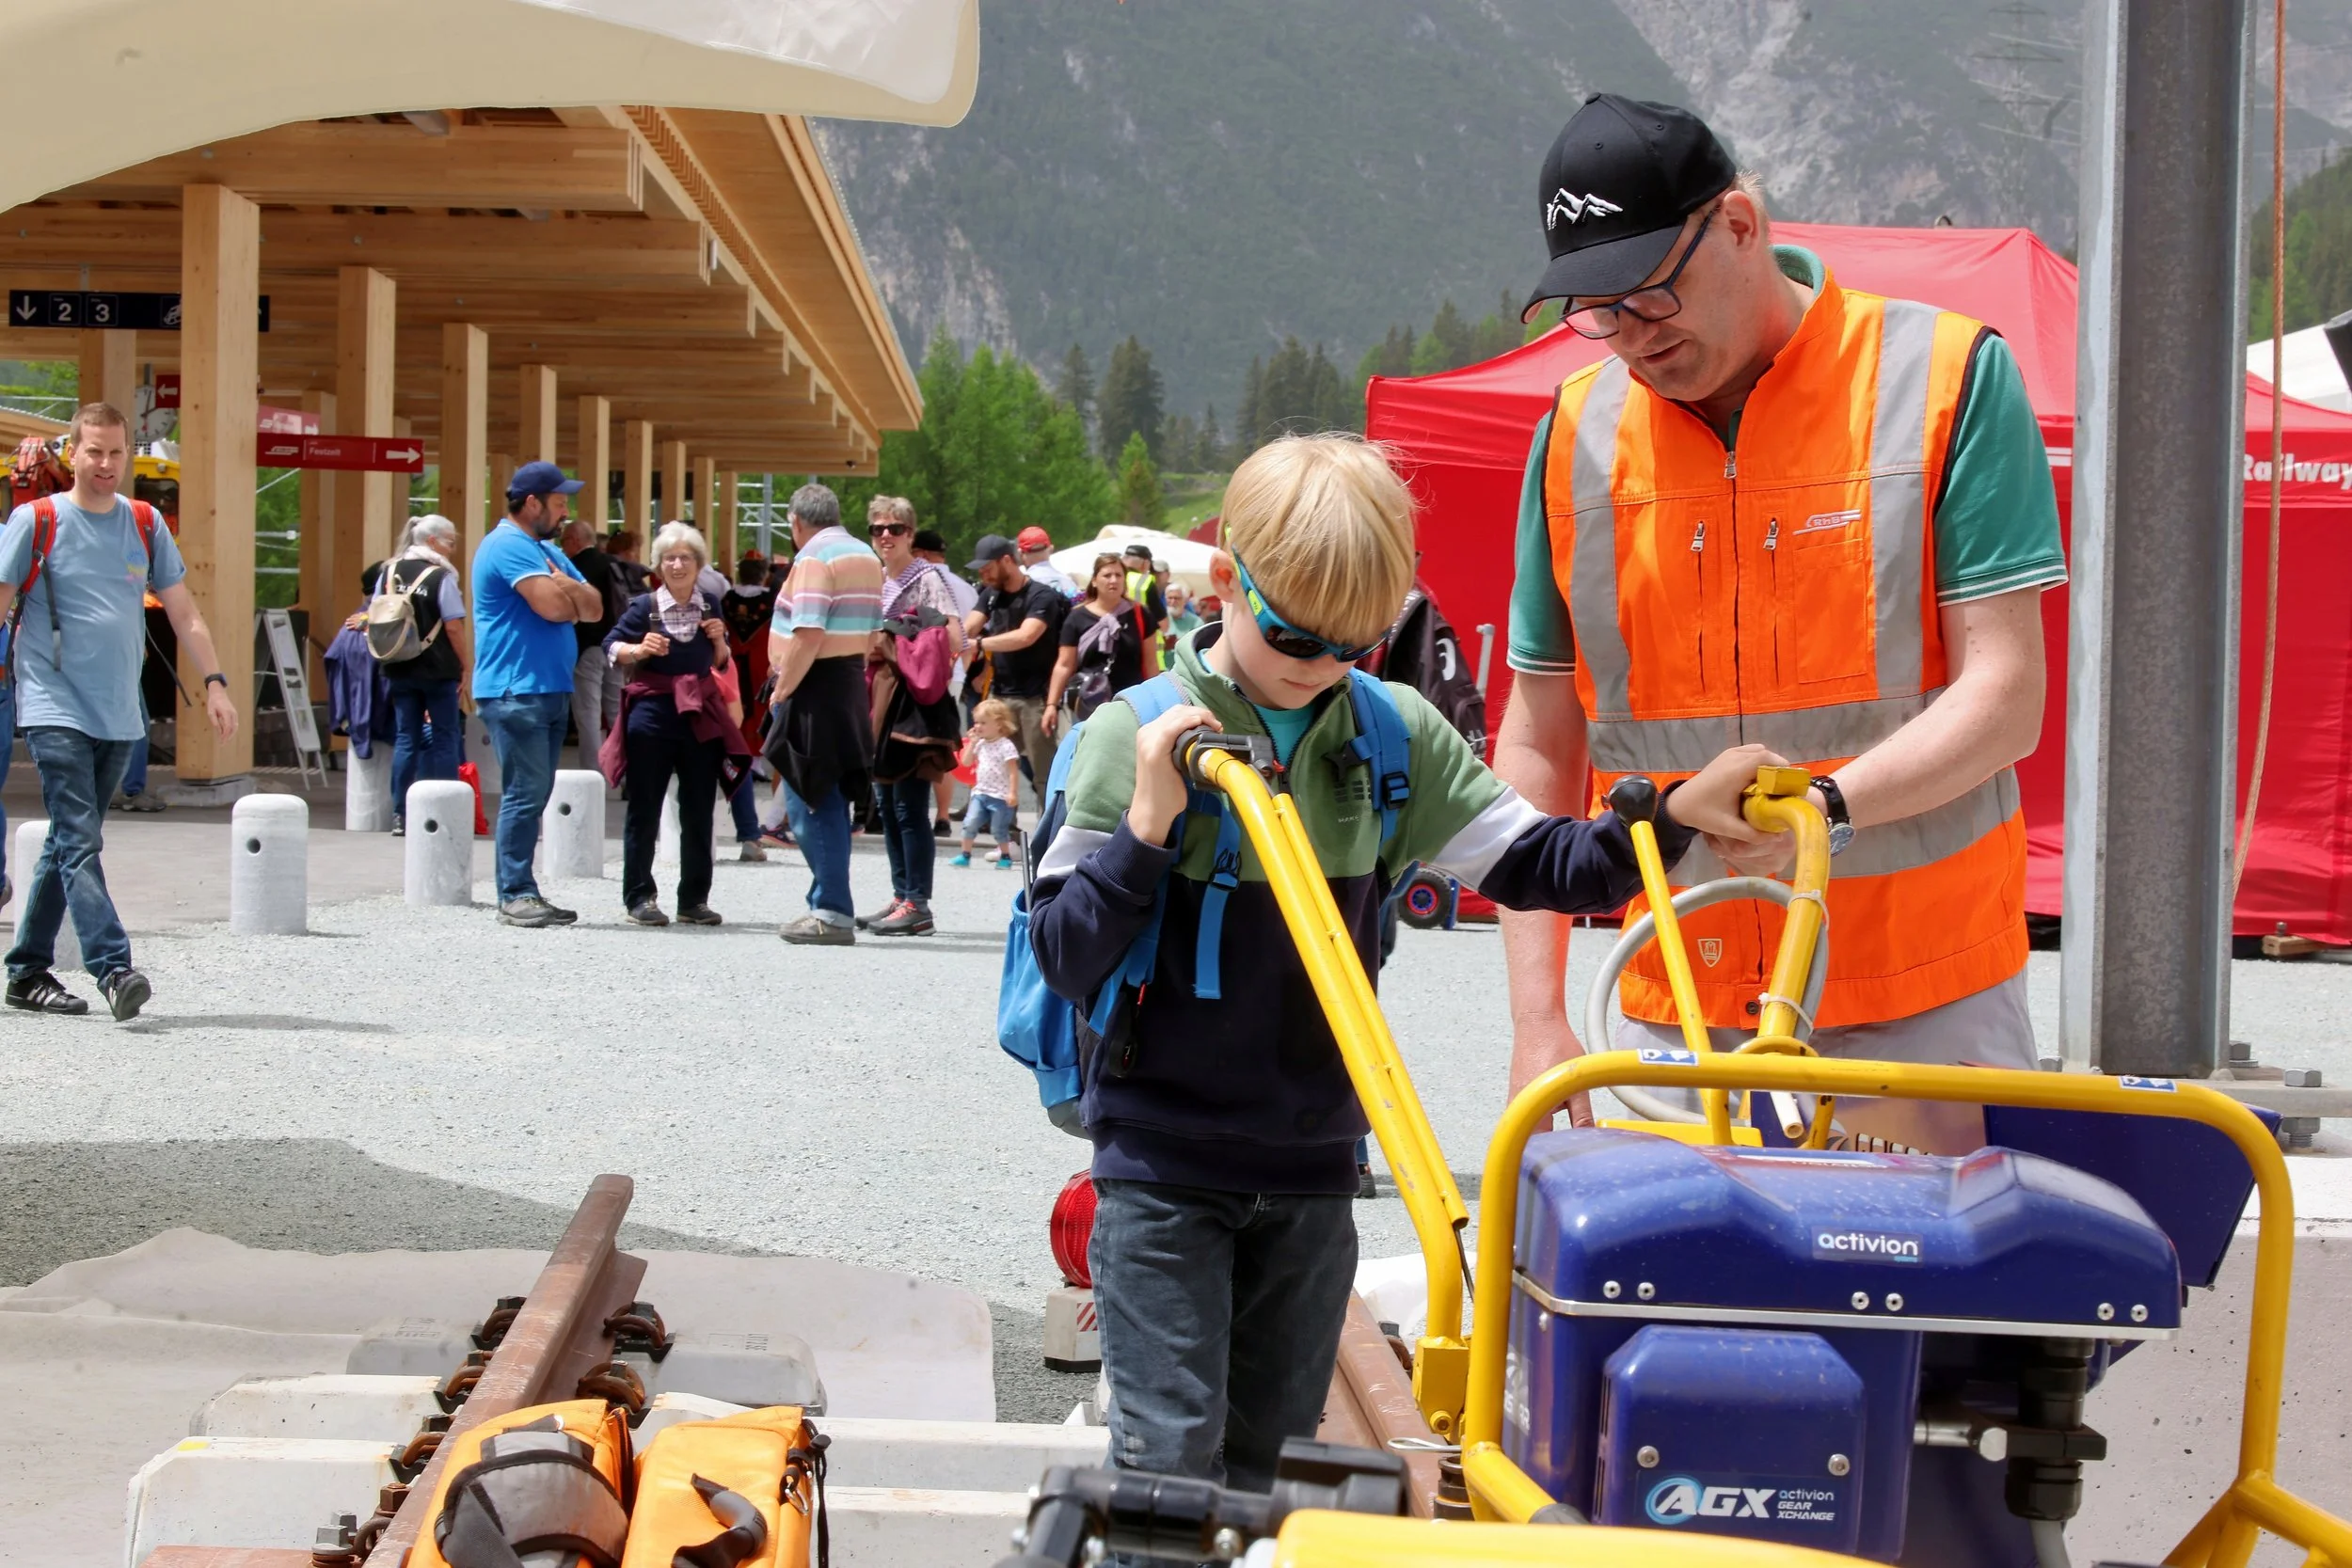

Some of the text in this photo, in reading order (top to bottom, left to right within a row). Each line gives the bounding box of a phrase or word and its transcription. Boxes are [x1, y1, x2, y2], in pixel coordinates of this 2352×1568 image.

[57, 302, 110, 323] 2 3
[1818, 1232, 1918, 1257] activion
[1656, 1484, 1776, 1519] AGX
[1778, 1489, 1835, 1501] activion
[1777, 1501, 1813, 1511] GEAR
[1776, 1511, 1835, 1521] XCHANGE
